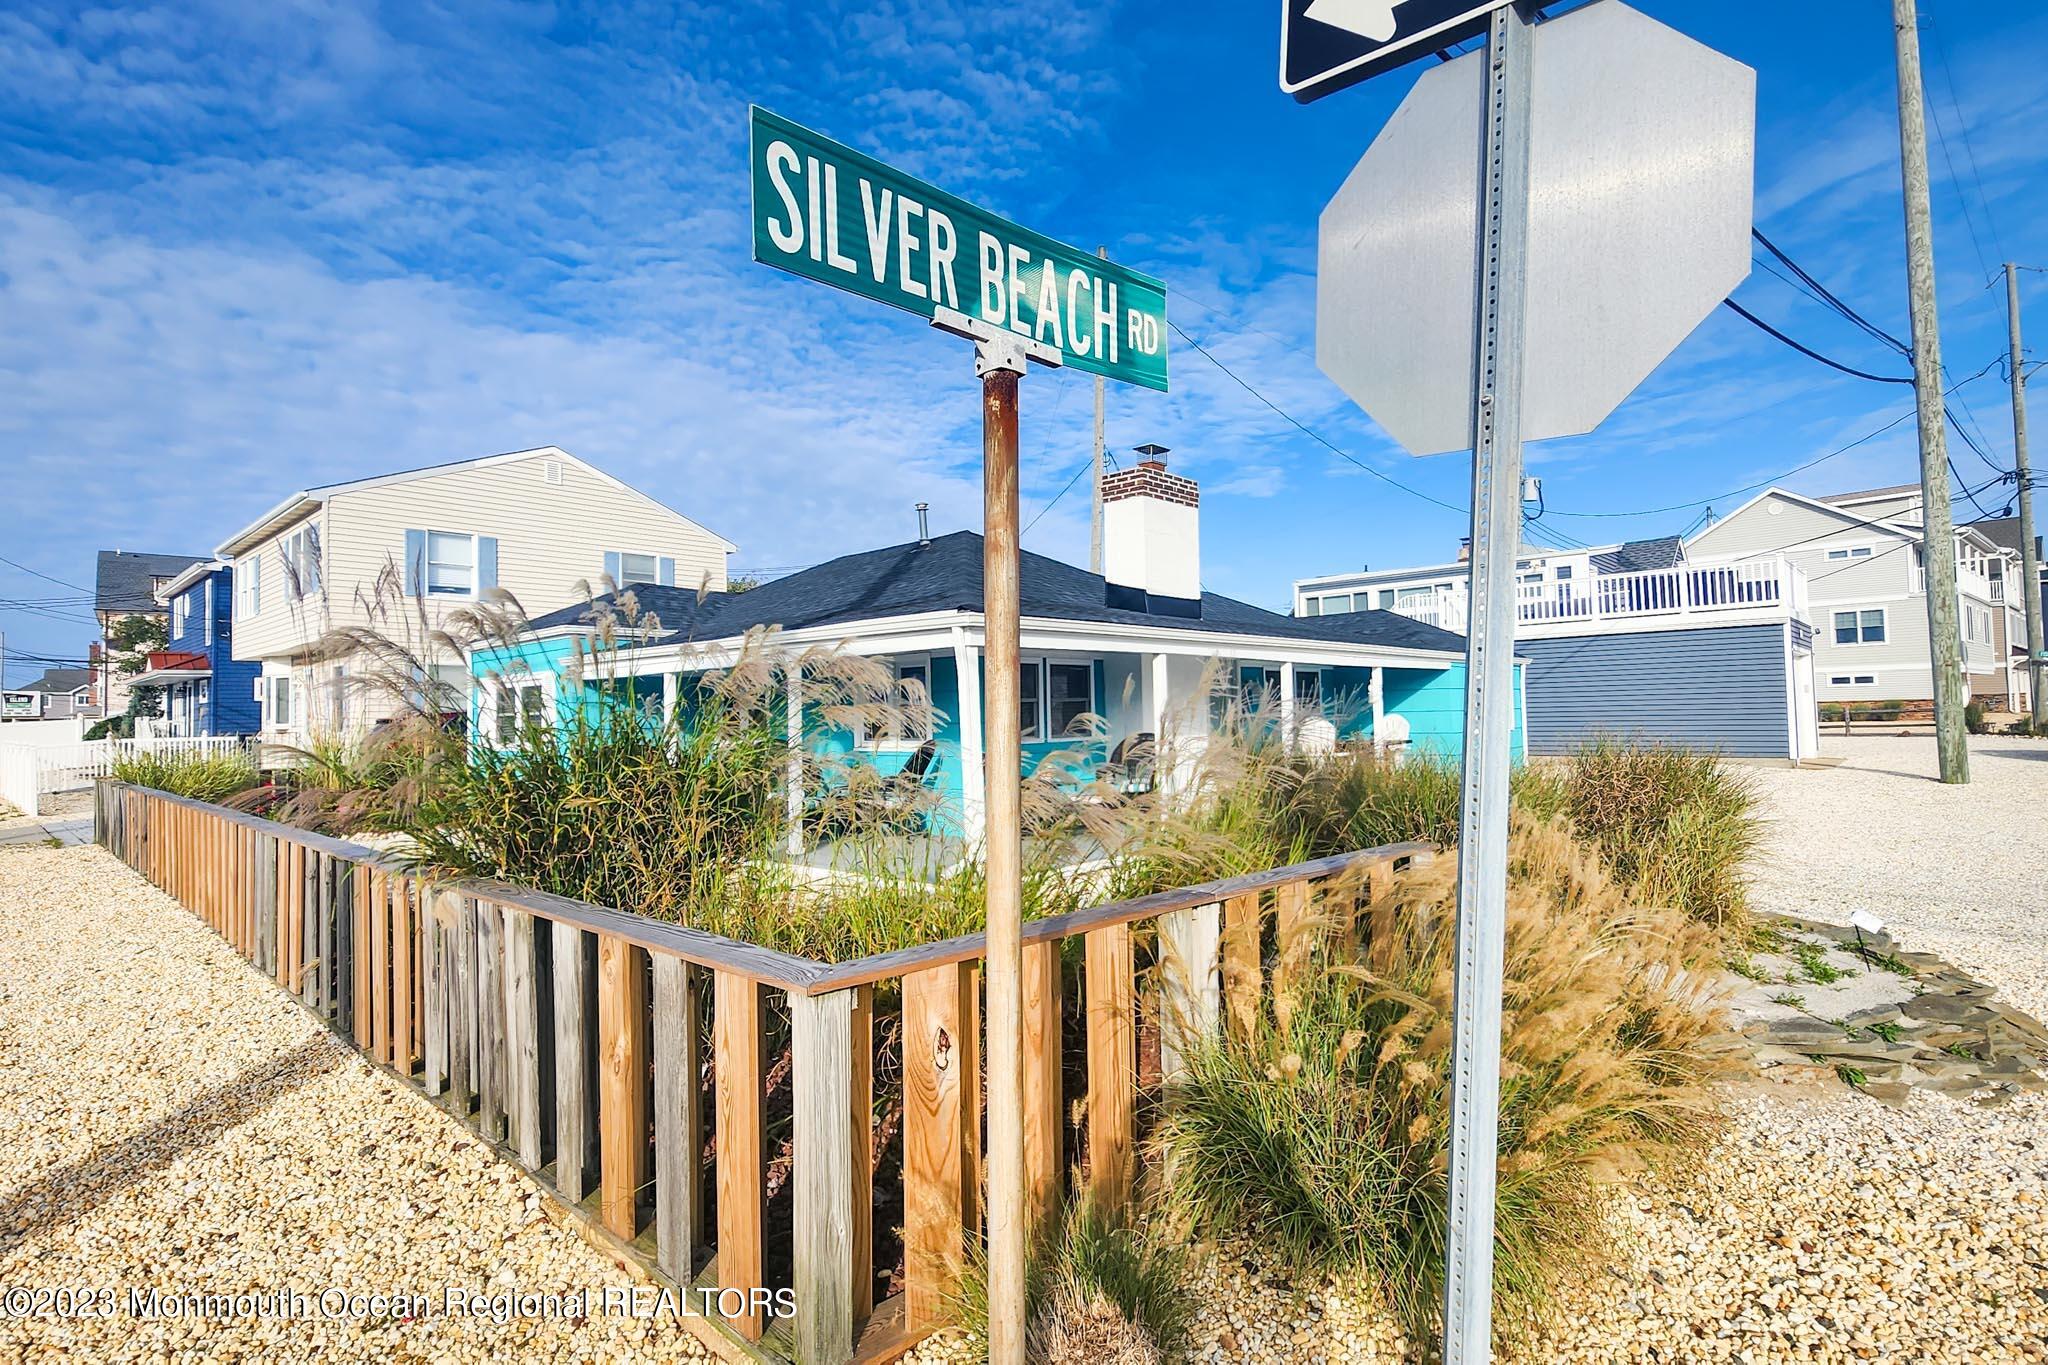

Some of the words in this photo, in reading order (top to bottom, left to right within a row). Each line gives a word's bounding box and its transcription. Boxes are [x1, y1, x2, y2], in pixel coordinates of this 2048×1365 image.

[766, 140, 959, 310] SILVER
[979, 230, 1119, 364] BEACH
[1127, 308, 1159, 356] RD
